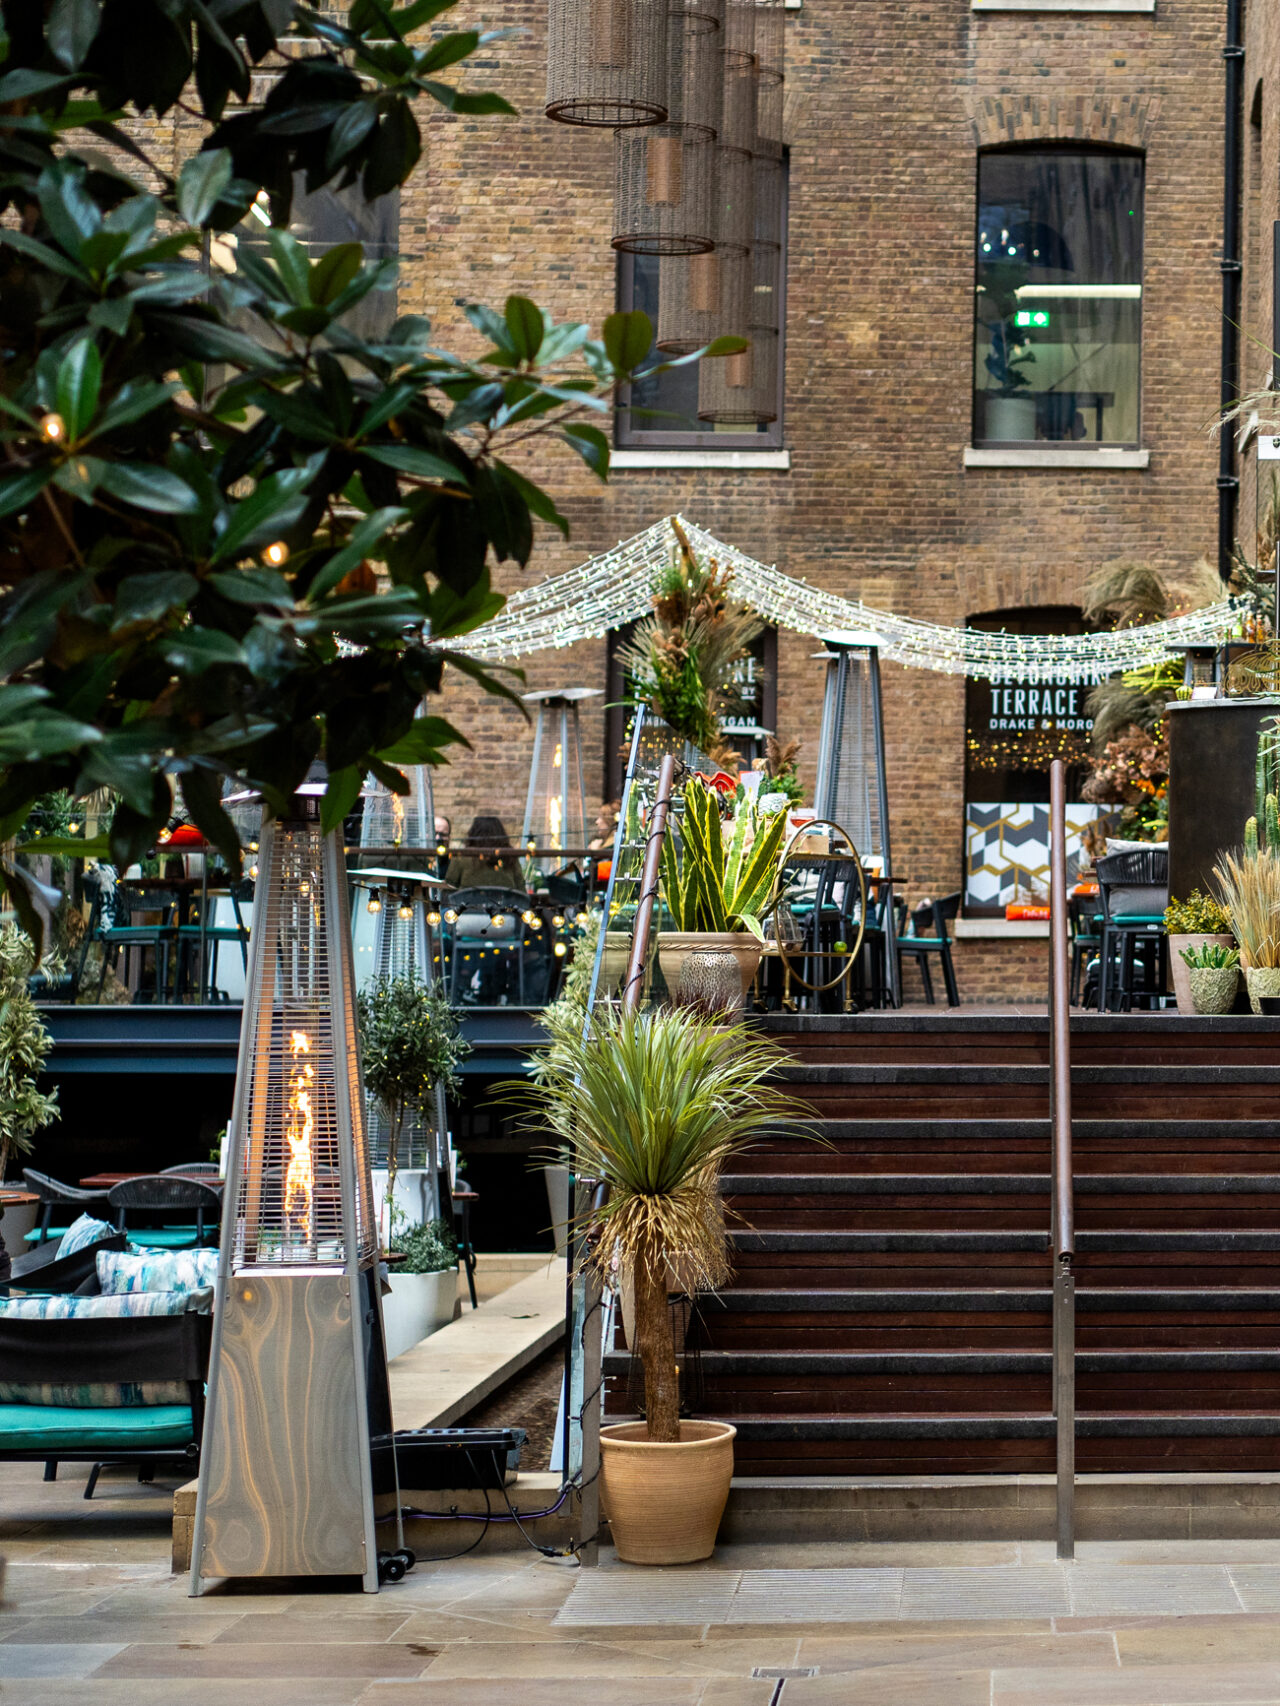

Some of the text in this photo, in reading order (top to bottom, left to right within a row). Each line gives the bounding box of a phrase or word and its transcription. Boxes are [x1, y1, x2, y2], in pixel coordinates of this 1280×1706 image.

[990, 688, 1078, 715] TERRACE
[989, 718, 1035, 730] DRAKE
[1055, 718, 1094, 730] MORG
